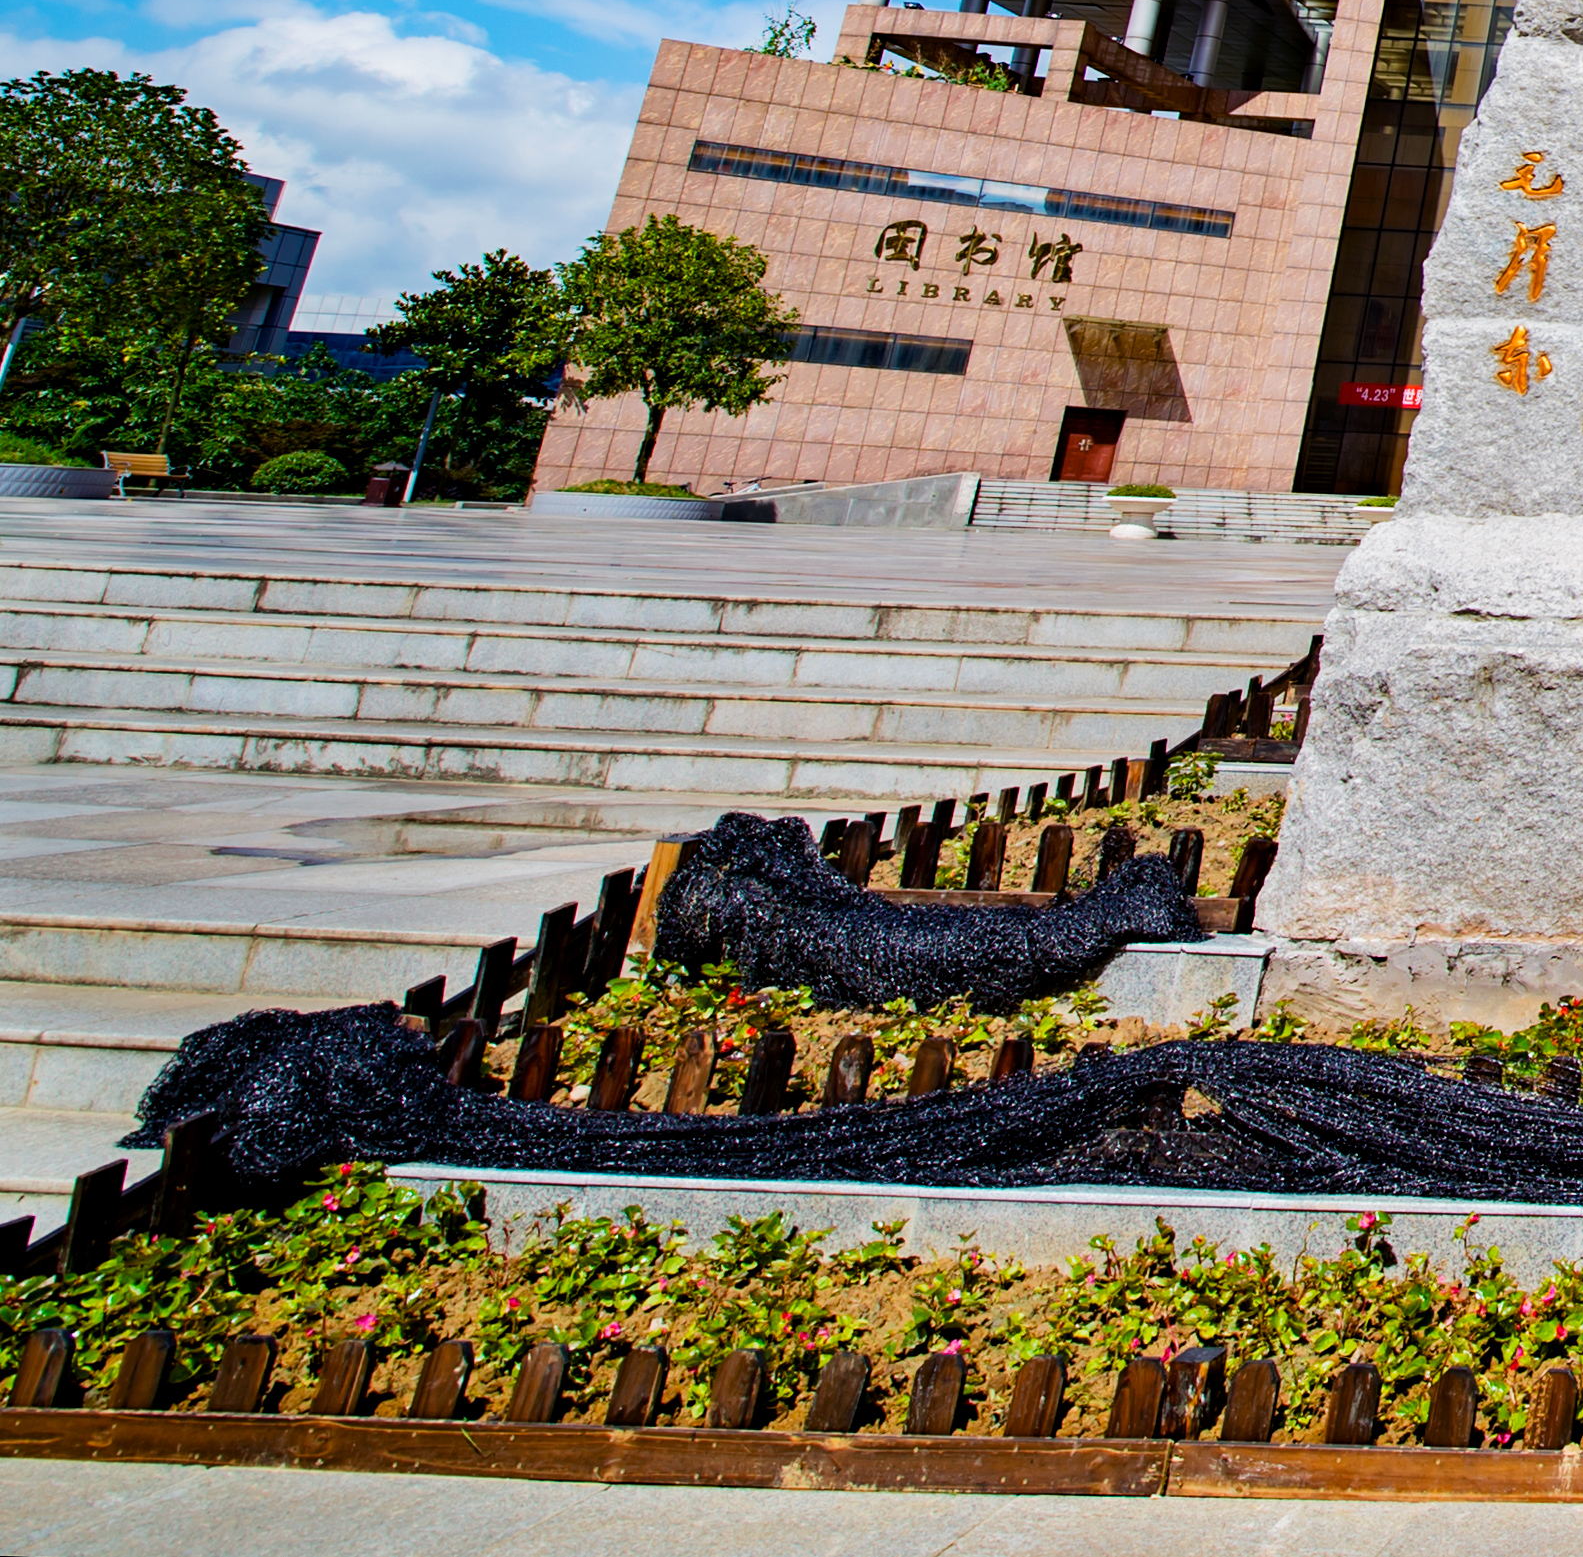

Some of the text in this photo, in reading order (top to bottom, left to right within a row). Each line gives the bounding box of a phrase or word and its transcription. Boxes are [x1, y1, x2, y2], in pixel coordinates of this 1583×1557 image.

[874, 219, 1083, 283] 图书馆
[866, 276, 1066, 311] LIBRARY
